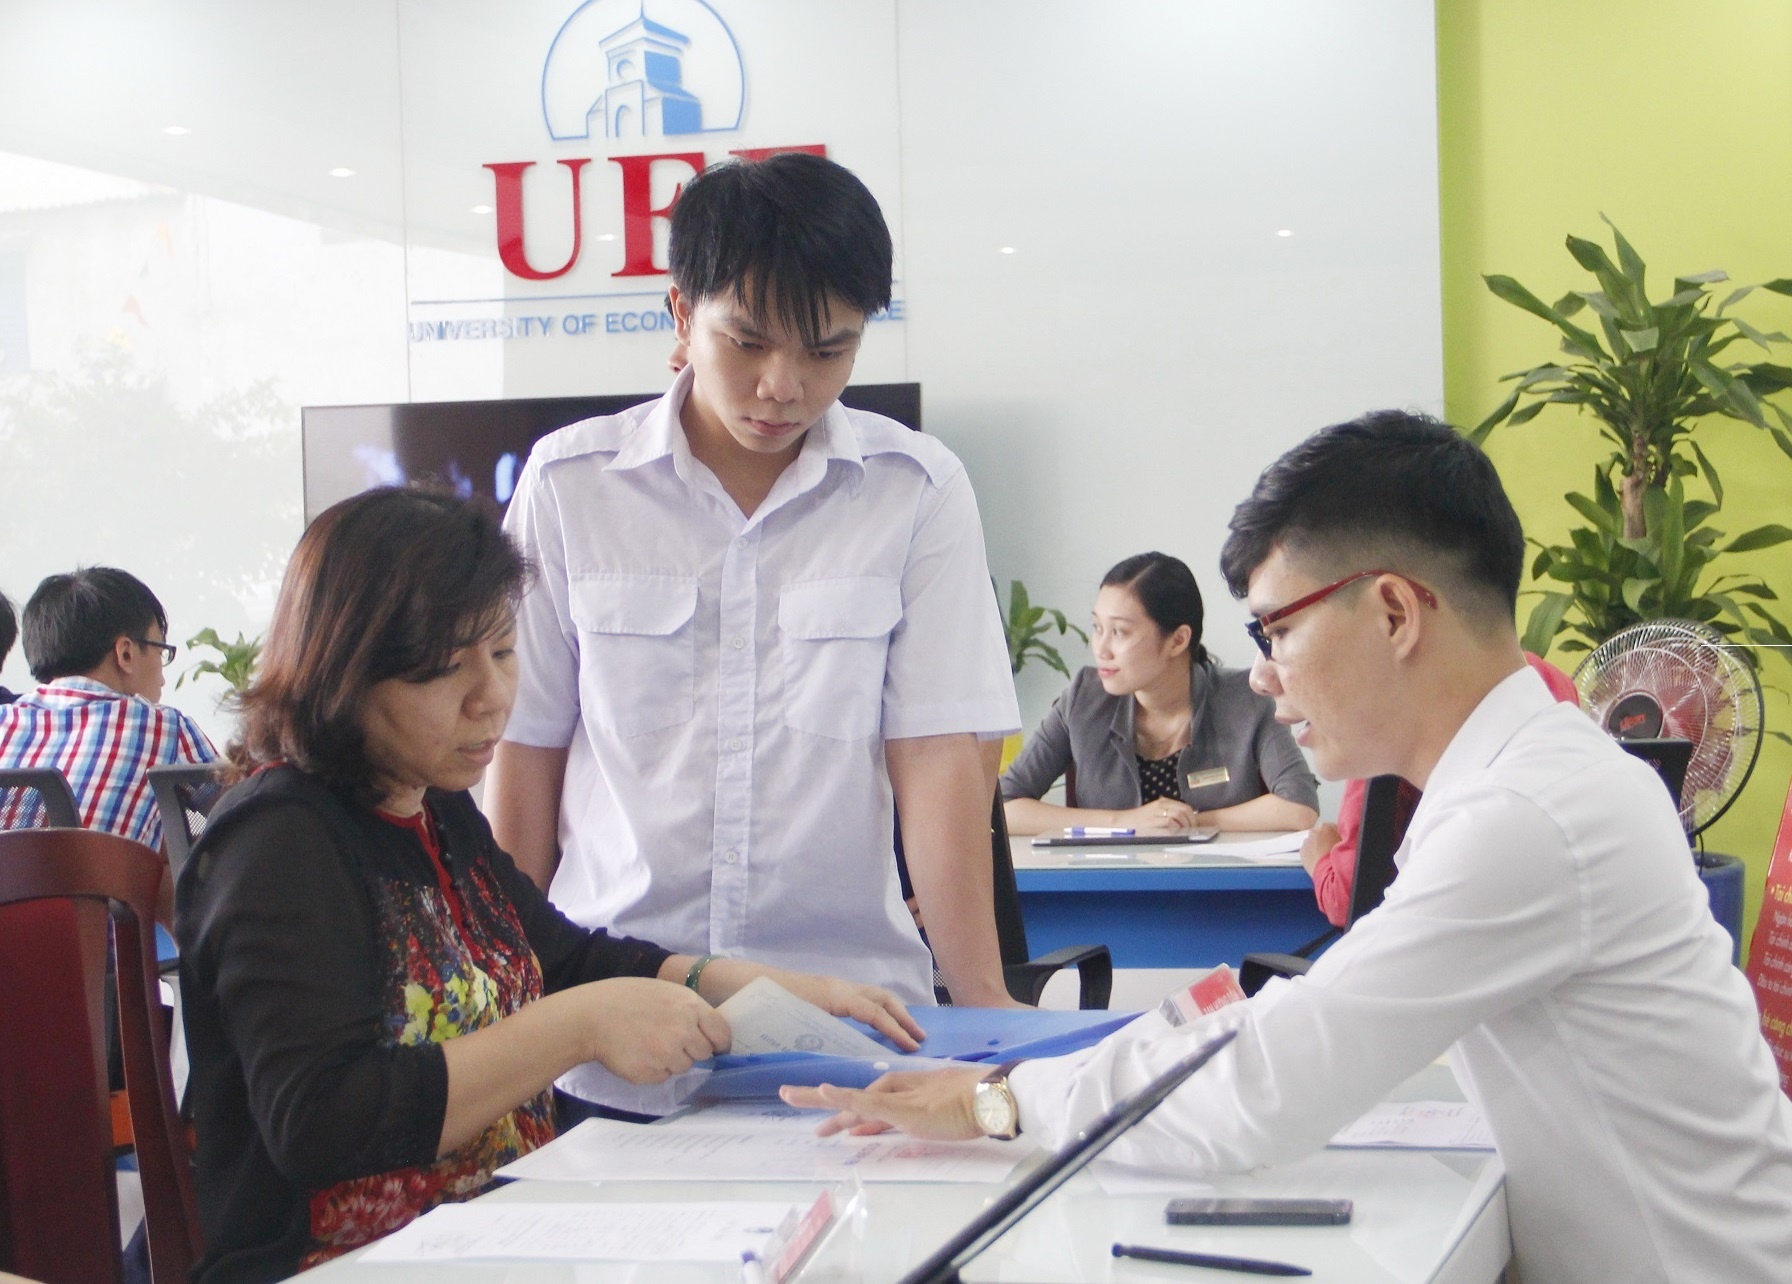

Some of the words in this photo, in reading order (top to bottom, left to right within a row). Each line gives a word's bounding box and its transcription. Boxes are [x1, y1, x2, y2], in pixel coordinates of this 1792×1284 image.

[482, 144, 826, 281] UE
[409, 316, 553, 342] UNIVERSITY
[562, 314, 596, 336] OF
